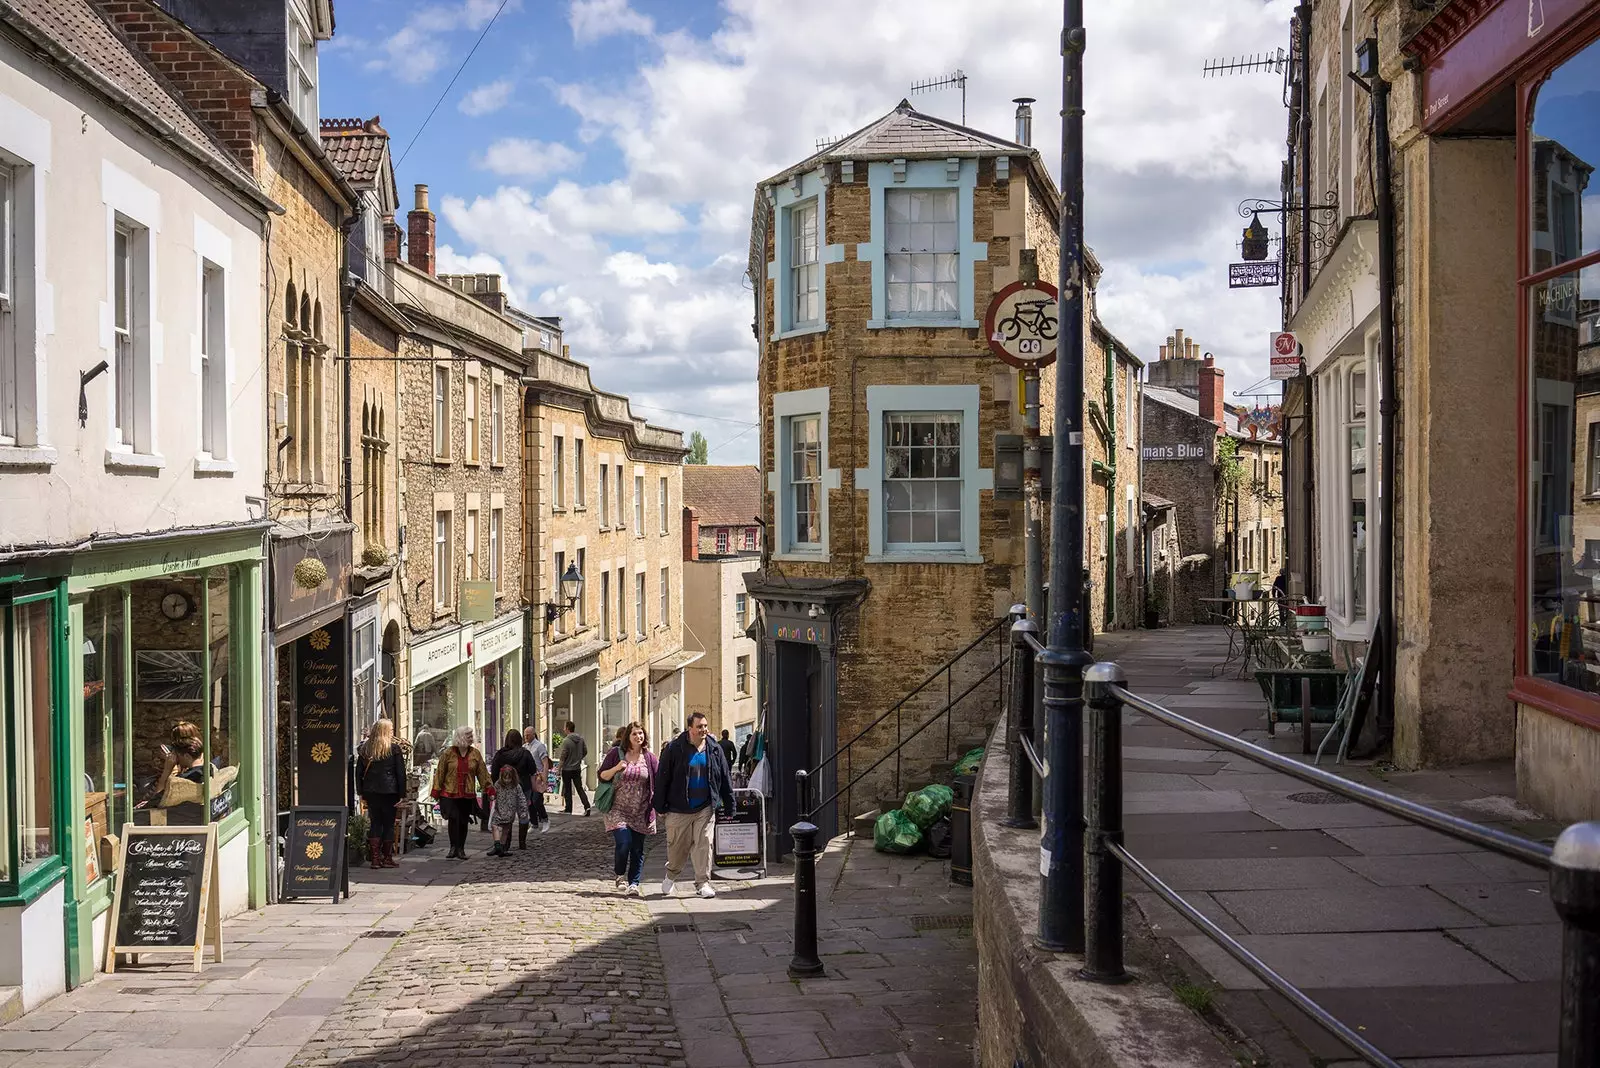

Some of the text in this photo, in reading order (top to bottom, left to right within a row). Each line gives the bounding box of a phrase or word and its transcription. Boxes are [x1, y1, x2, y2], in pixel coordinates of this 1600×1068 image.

[1539, 281, 1573, 307] MACHINE
[1143, 443, 1204, 457] man's Blue
[480, 636, 495, 652] HERBS
[495, 633, 502, 644] ON
[501, 629, 509, 641] THE
[509, 625, 517, 637] HILL
[428, 642, 457, 662] APOTHECARY
[303, 658, 338, 673] Vintage
[304, 674, 338, 686] Bridal
[303, 704, 339, 718] Bespoke
[302, 719, 341, 733] Tailoring
